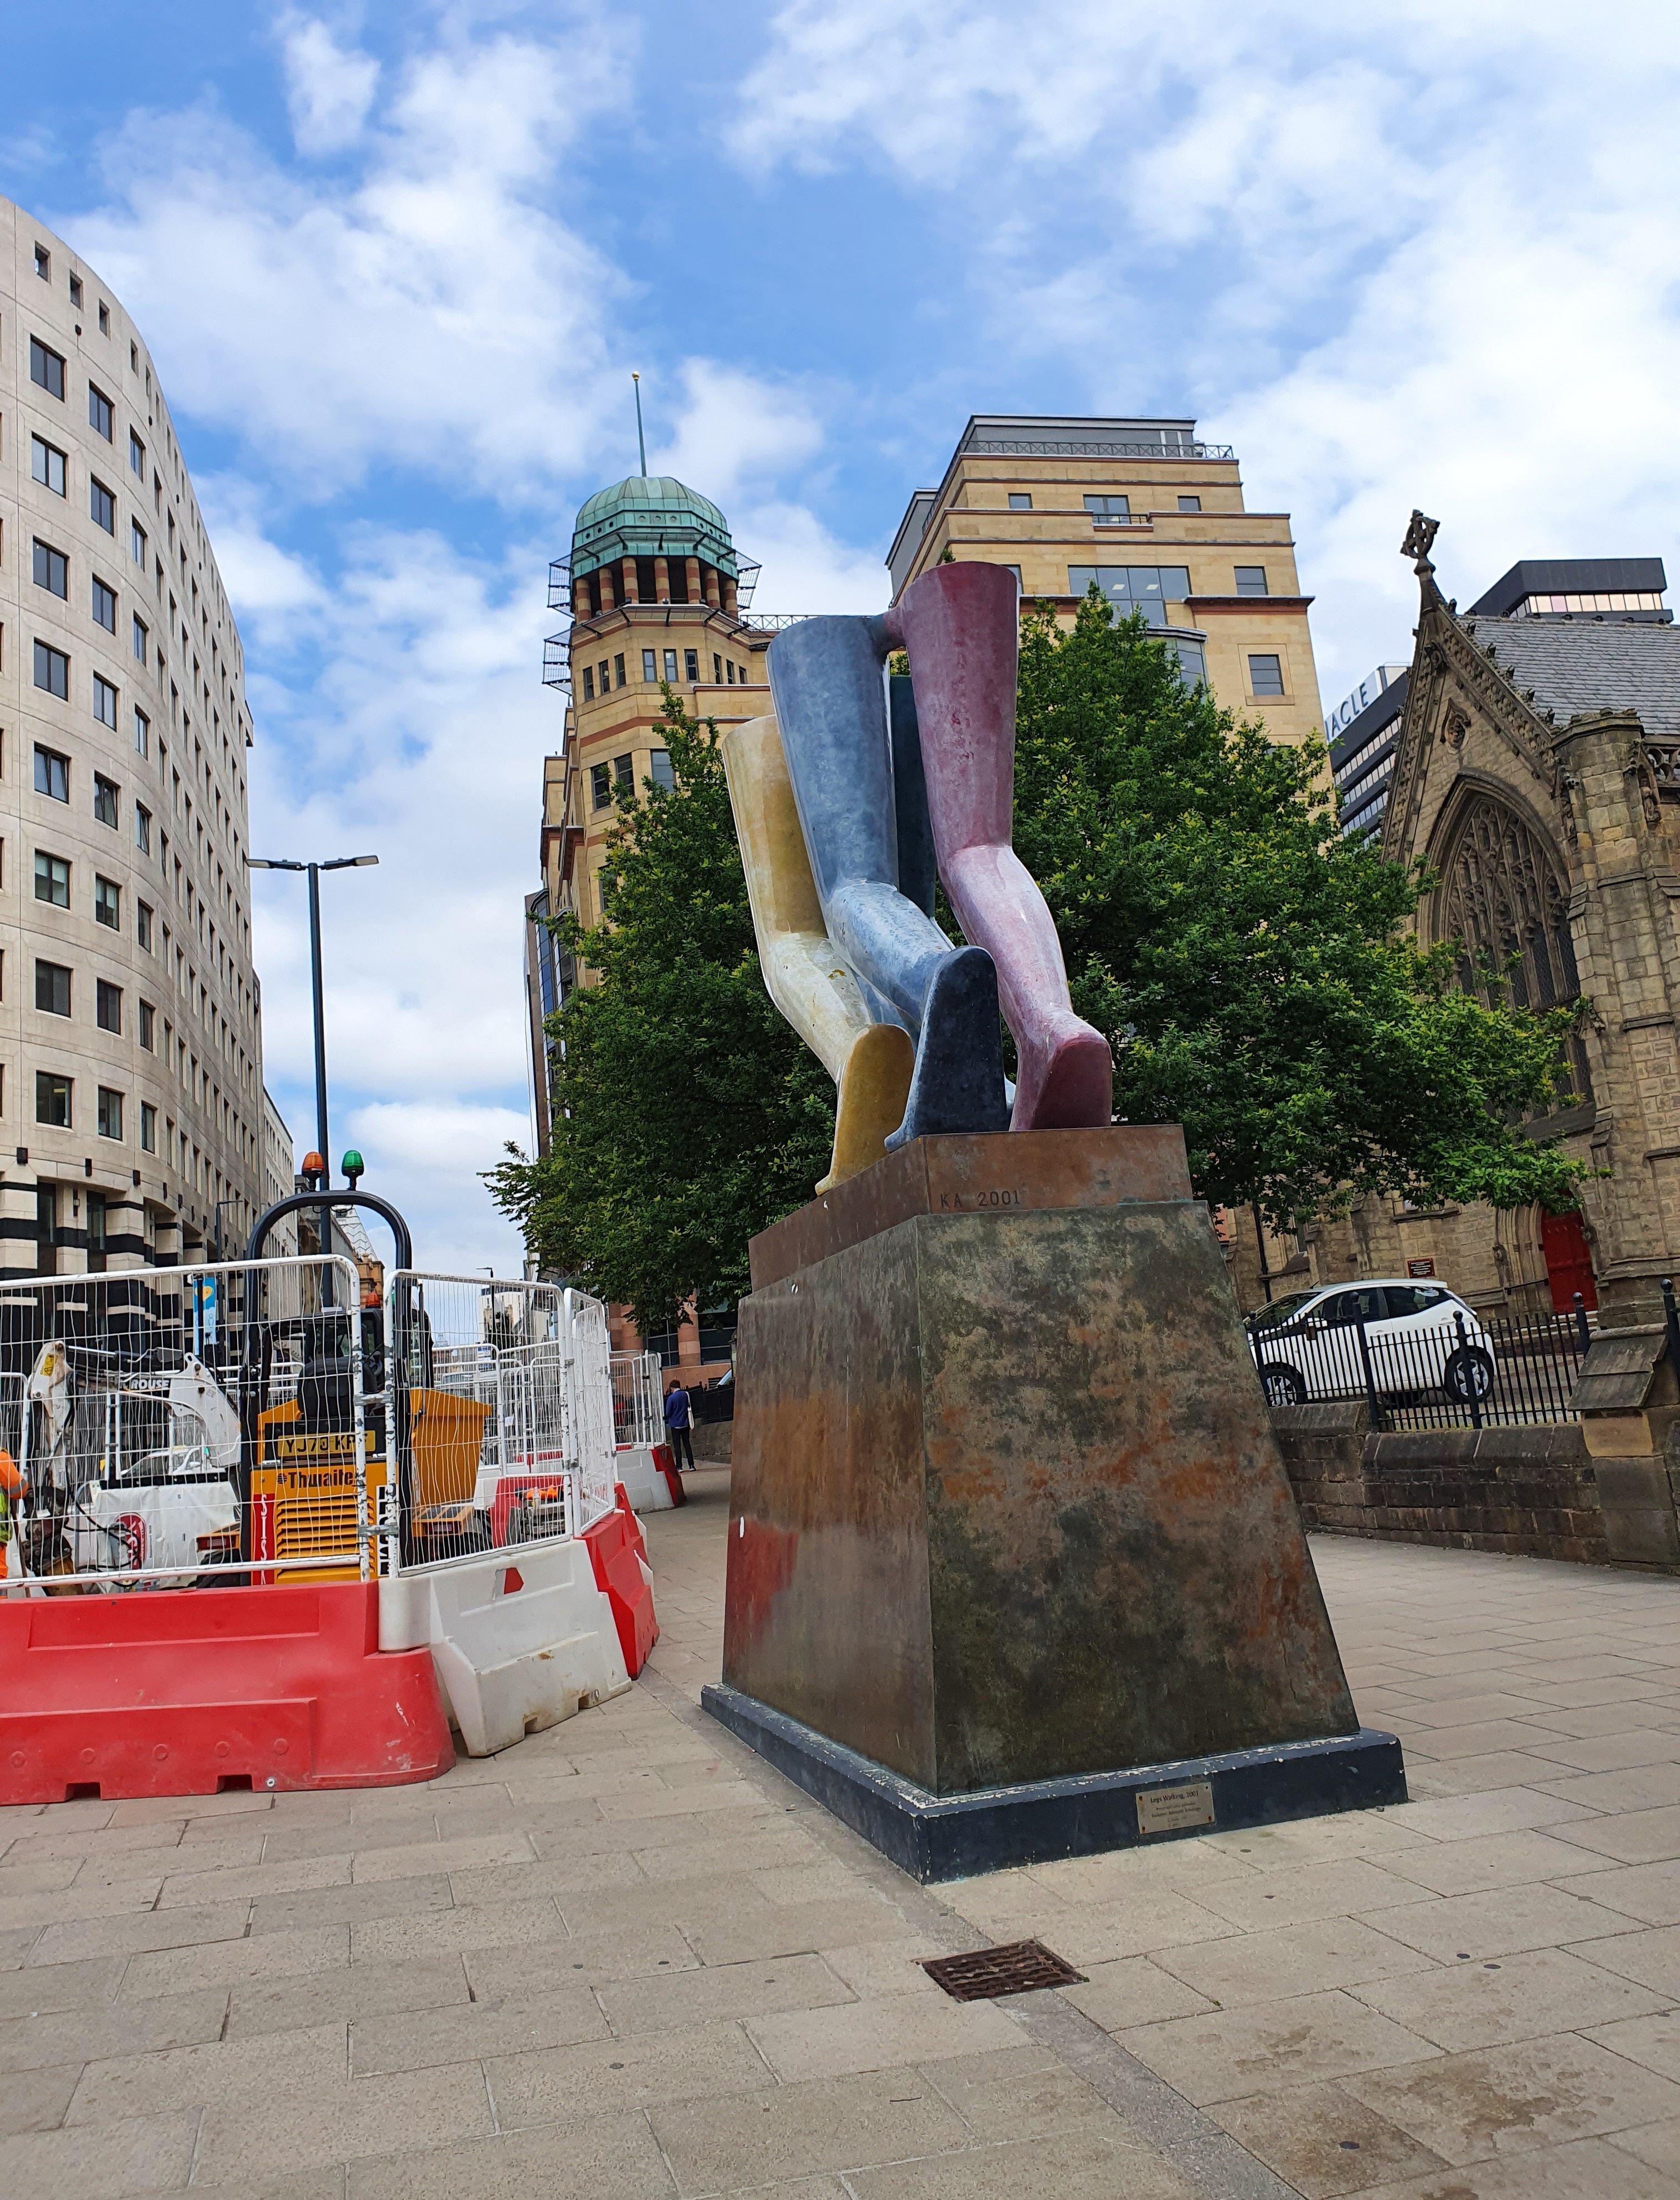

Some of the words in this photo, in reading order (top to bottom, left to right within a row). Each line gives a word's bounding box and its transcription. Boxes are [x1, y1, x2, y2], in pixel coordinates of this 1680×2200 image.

[977, 1190, 1020, 1207] 2001
[131, 1379, 169, 1390] ROUSE
[335, 1433, 368, 1451] KP
[288, 1469, 356, 1488] Thwaite
